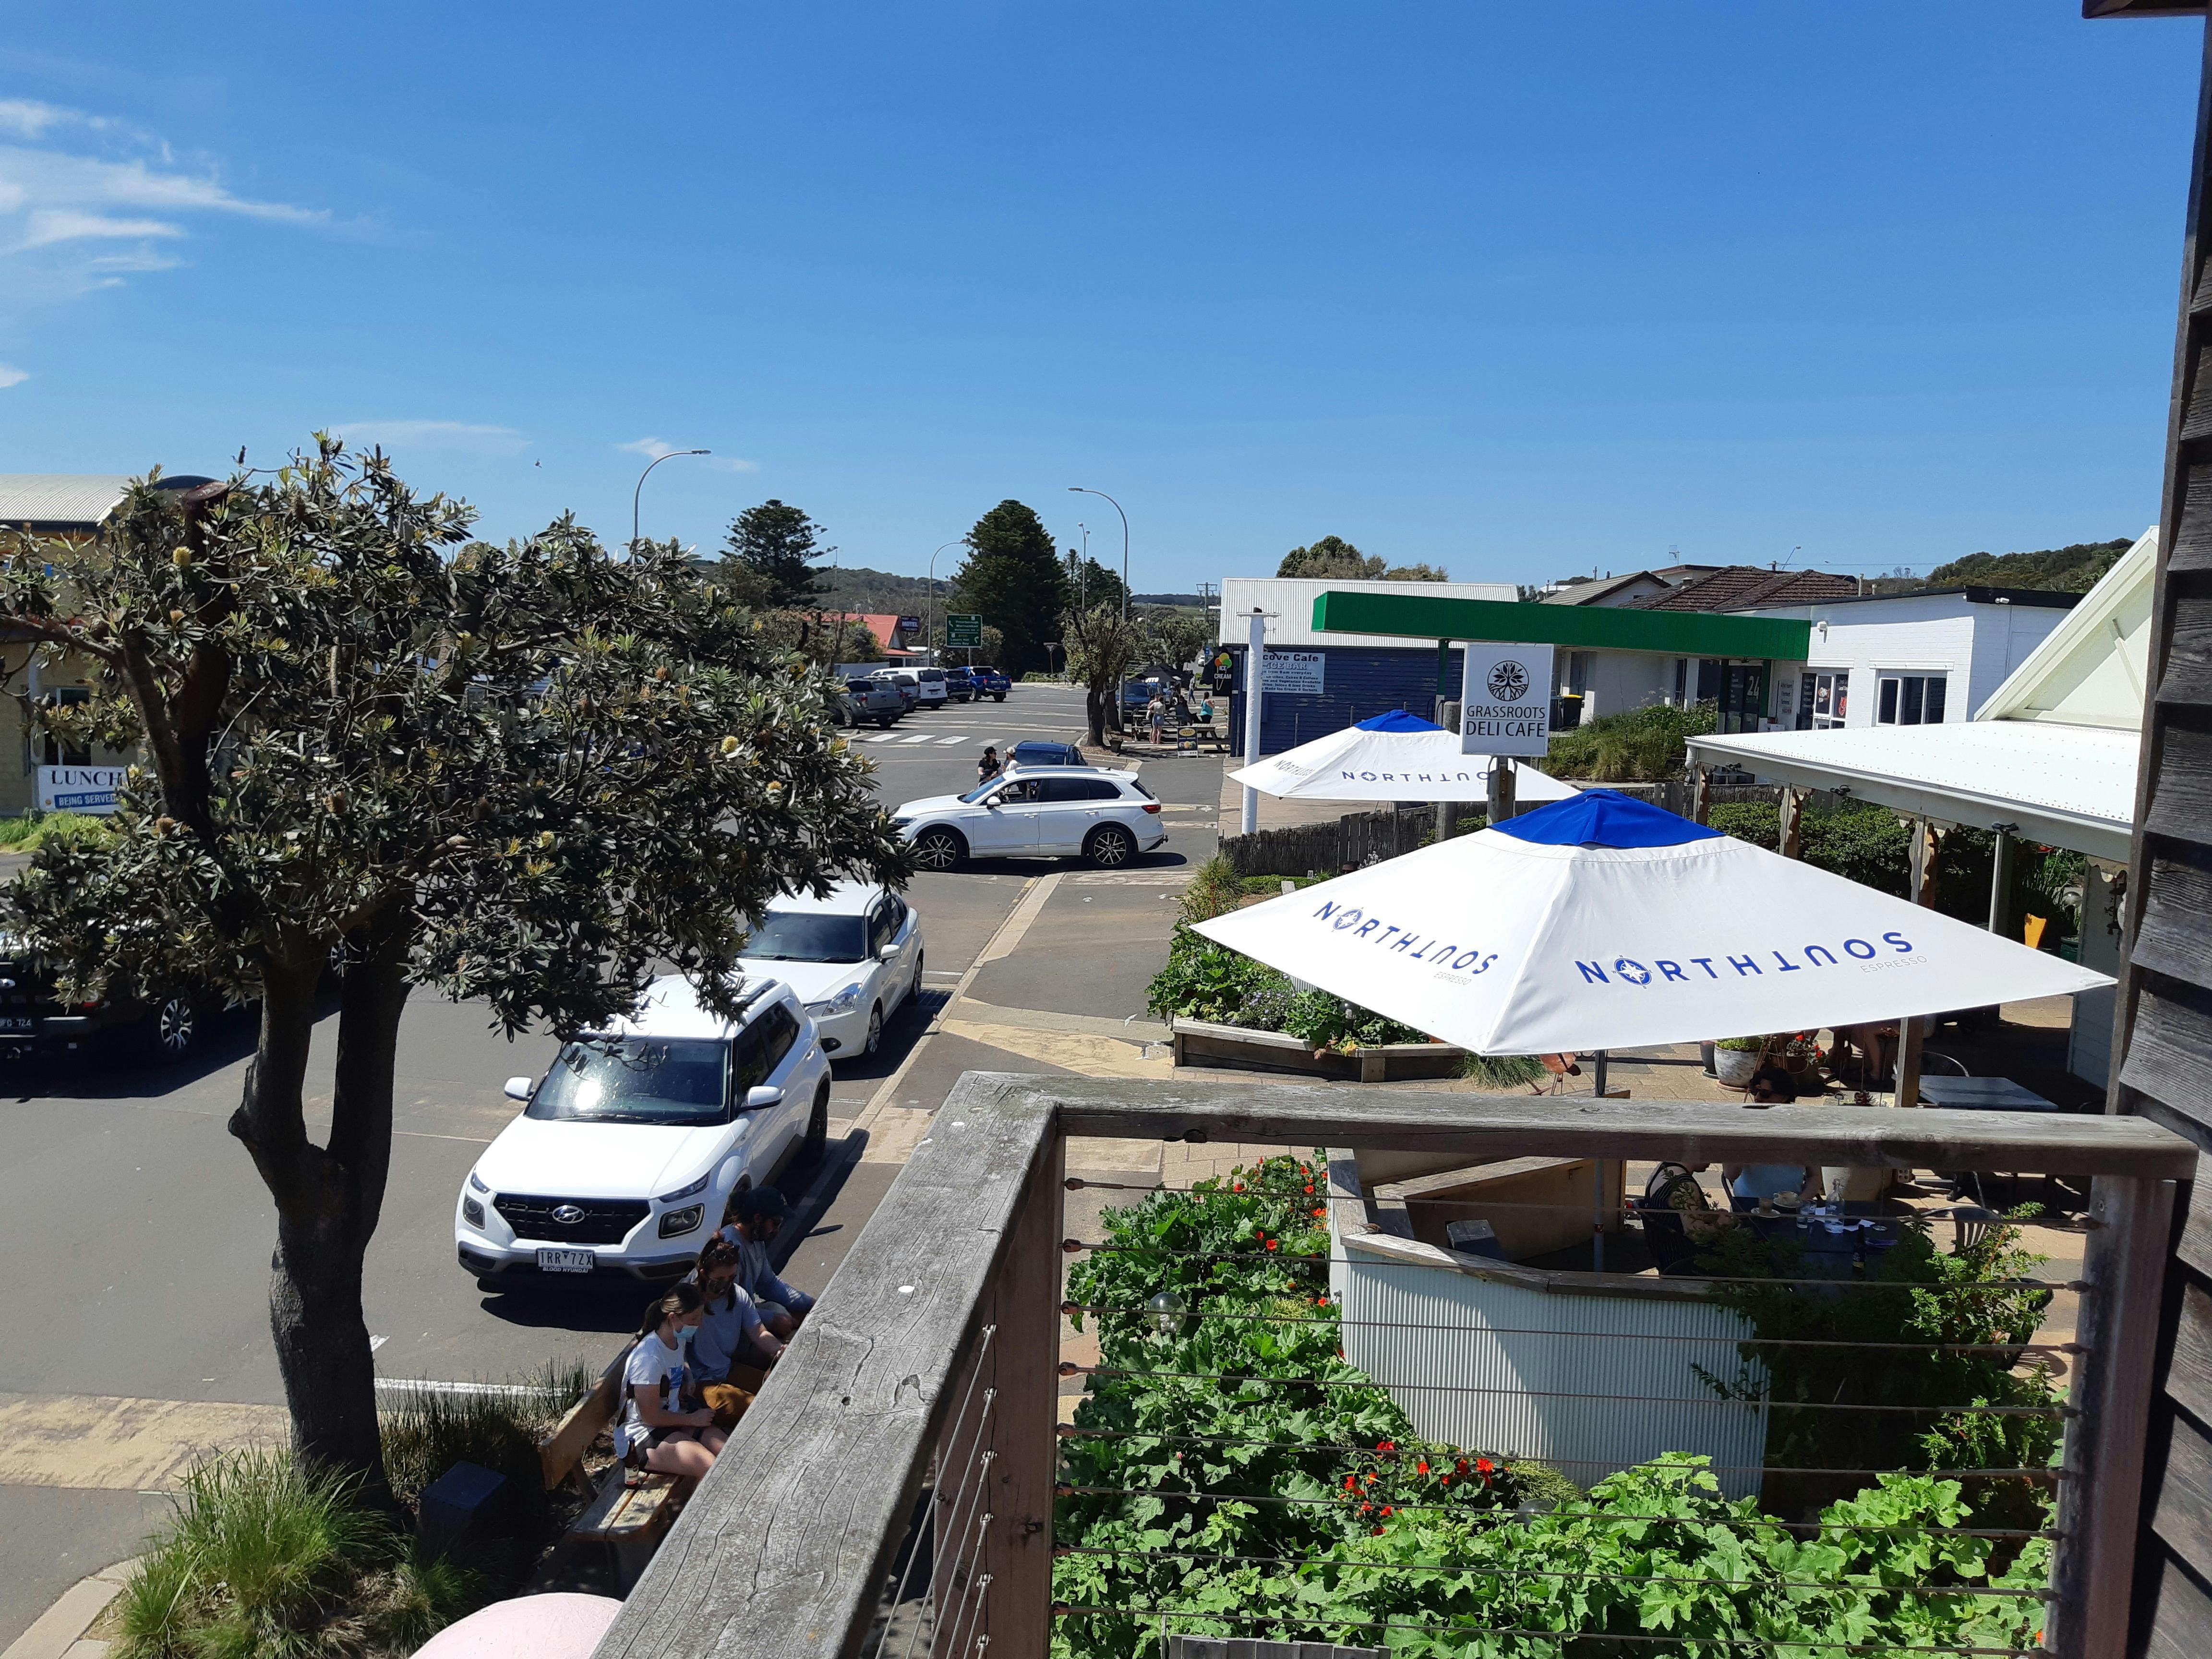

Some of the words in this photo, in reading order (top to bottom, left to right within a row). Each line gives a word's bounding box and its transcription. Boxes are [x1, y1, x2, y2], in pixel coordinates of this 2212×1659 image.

[1294, 654, 1319, 662] Cafe
[1467, 705, 1545, 719] GRASSROOTS
[1466, 721, 1500, 736] DELI
[1505, 722, 1545, 737] CAFE
[51, 770, 123, 786] LUNCH
[59, 795, 83, 806] BEING
[1860, 955, 1928, 973] ESPRESSO
[1433, 971, 1472, 986] ESPRESSO
